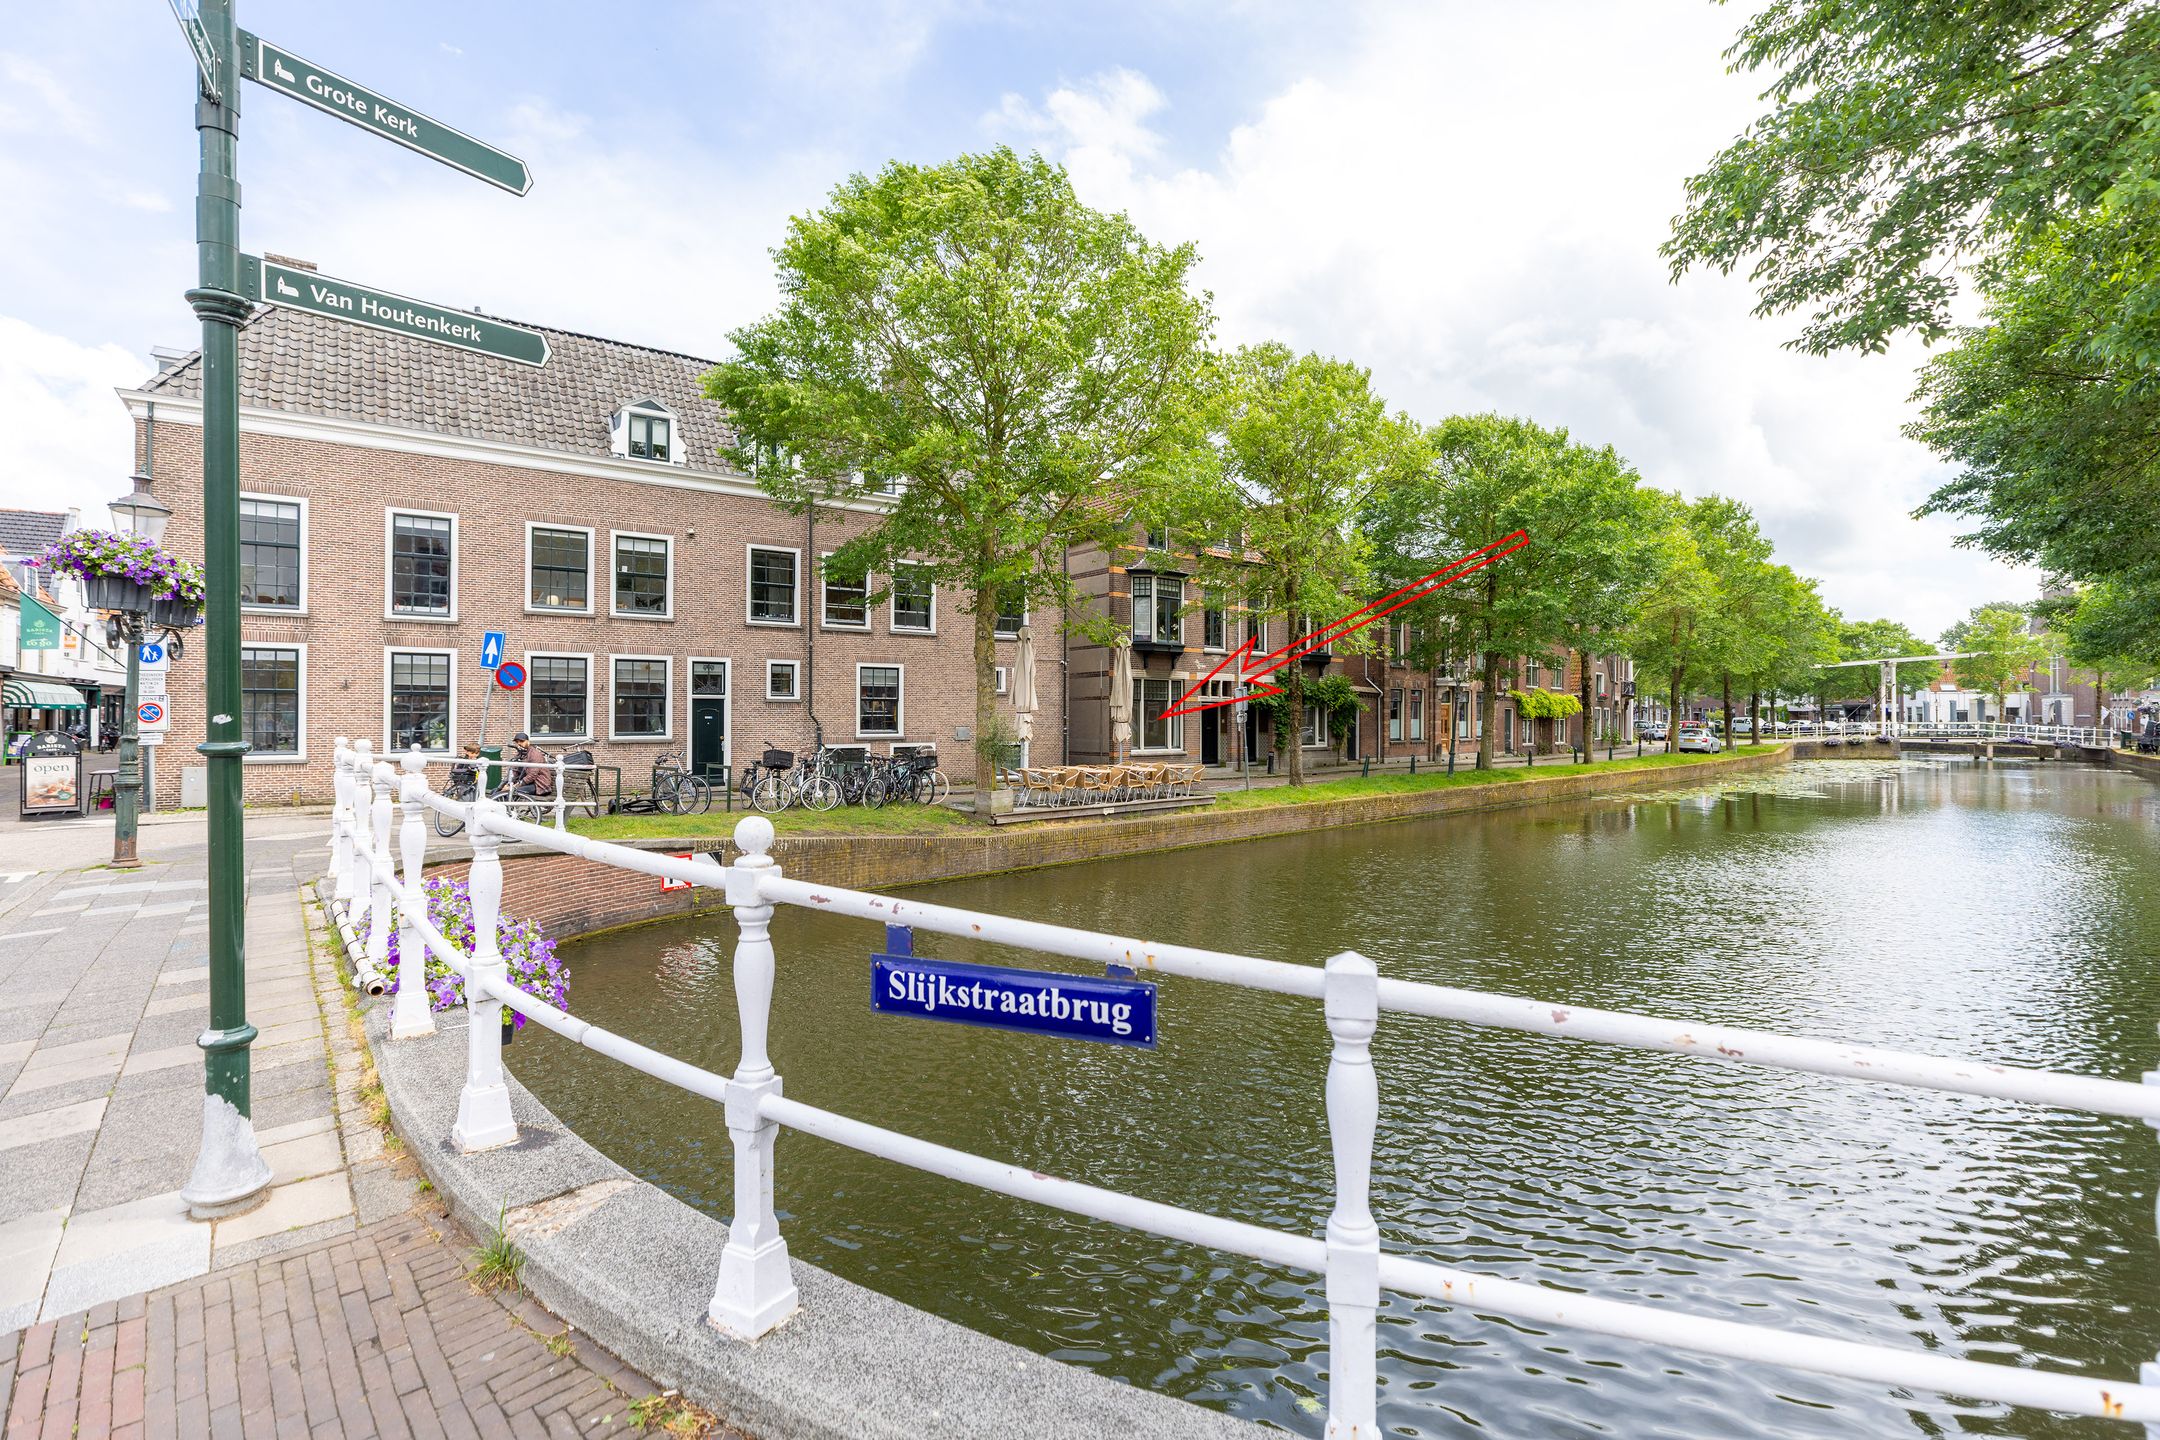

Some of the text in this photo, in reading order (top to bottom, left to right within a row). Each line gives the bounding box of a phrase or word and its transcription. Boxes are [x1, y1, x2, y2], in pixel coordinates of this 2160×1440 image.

[306, 75, 418, 138] Grote Kerk
[310, 284, 481, 342] Van Houtenkerk
[33, 764, 70, 775] open
[888, 969, 1133, 1035] Slijkstraatbrug
